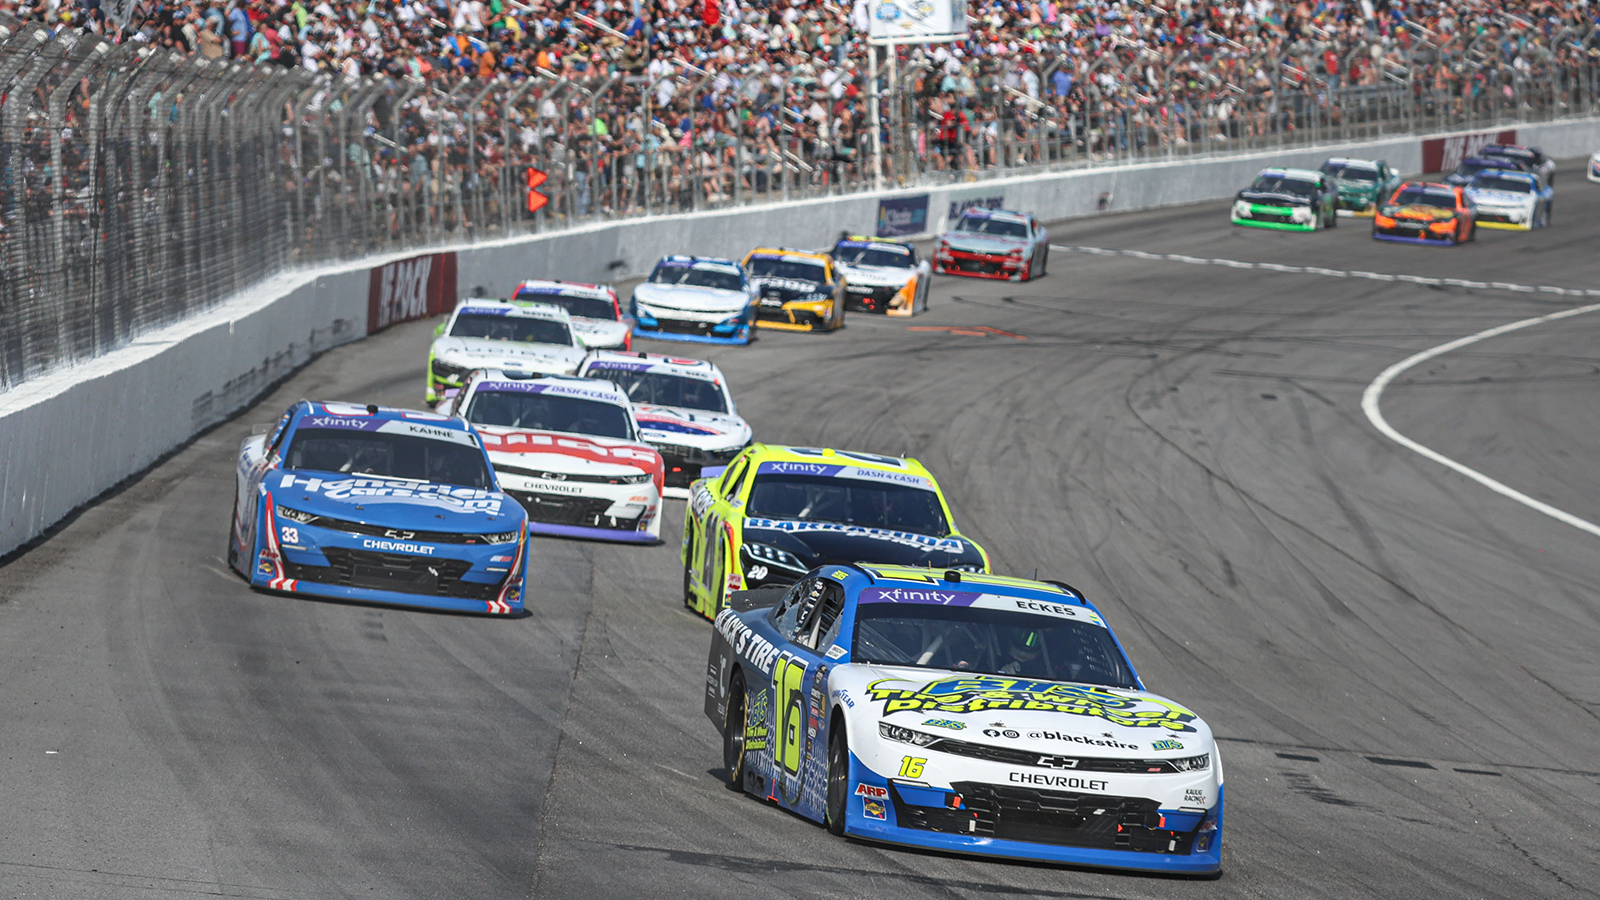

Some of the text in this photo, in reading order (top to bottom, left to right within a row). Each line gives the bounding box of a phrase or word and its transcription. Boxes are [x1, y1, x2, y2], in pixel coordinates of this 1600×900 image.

[488, 382, 535, 392] xfinity
[590, 391, 618, 401] CASH
[312, 417, 369, 429] xfinity
[409, 426, 454, 438] KAHNE
[771, 463, 827, 475] xfinity
[856, 469, 885, 479] DASH
[894, 475, 920, 484] CASH
[524, 482, 584, 494] CHEVROLET
[281, 526, 299, 543] 33
[744, 518, 964, 553] BARRACUDA
[363, 539, 435, 555] CHEVROLET
[747, 565, 769, 580] 20
[878, 588, 955, 605] xfinity
[1015, 600, 1076, 617] ECKES
[714, 608, 752, 654] BLACK'S
[745, 634, 780, 675] TIRE
[772, 650, 809, 778] 16
[886, 698, 1186, 731] Distributors
[1027, 731, 1139, 750] @blackstire
[898, 755, 927, 778] 16
[1009, 772, 1108, 791] CHEVROLET
[857, 784, 888, 798] ARP
